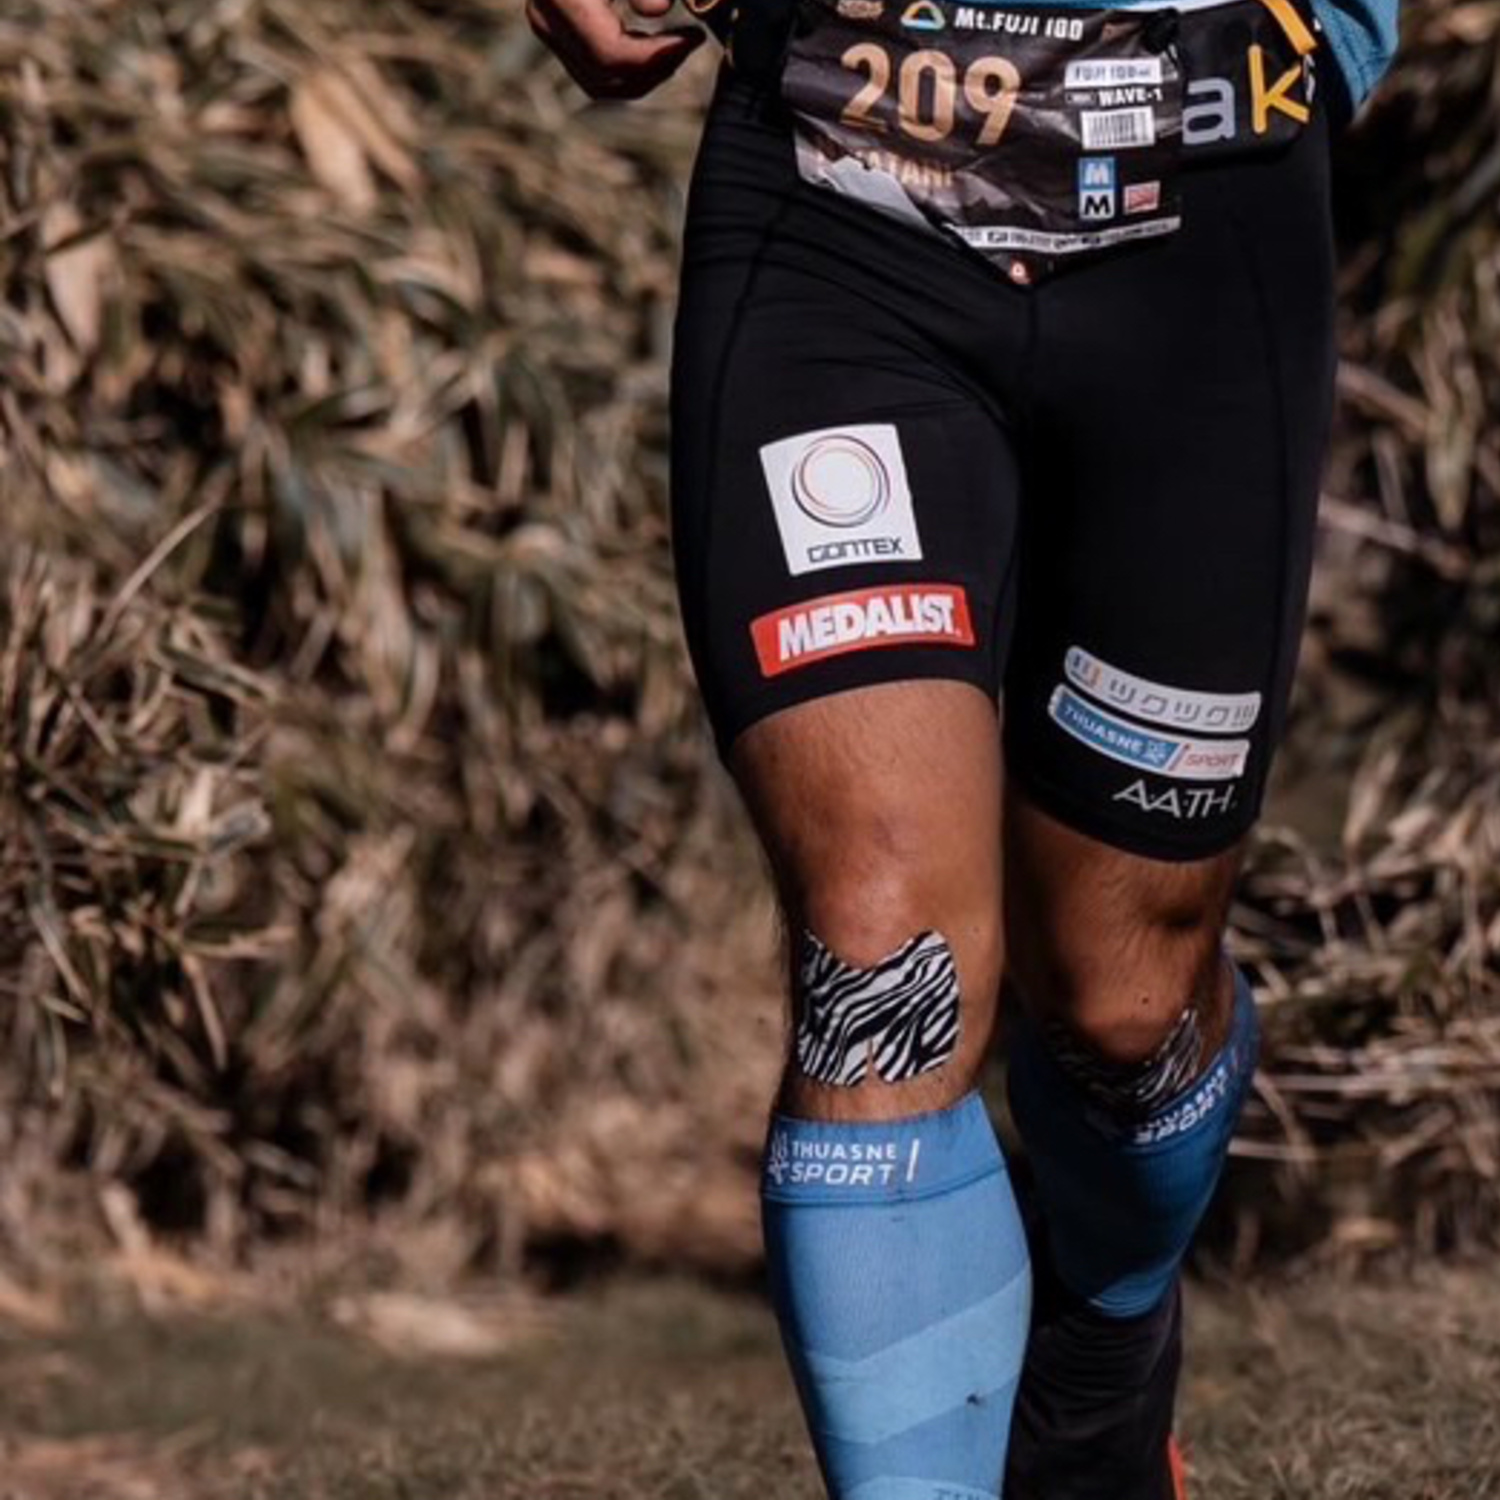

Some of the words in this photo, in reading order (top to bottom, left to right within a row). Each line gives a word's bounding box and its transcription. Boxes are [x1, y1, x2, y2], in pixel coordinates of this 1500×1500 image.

[1045, 17, 1084, 41] 100
[839, 41, 1022, 145] 209
[1099, 86, 1163, 107] WAVE-1
[1083, 194, 1111, 217] M
[779, 592, 956, 661] MEDALIST
[1064, 704, 1143, 755] THUASNE
[1182, 752, 1239, 768] SPORT
[791, 1140, 898, 1162] THUASNE
[789, 1161, 895, 1186] SPORT
